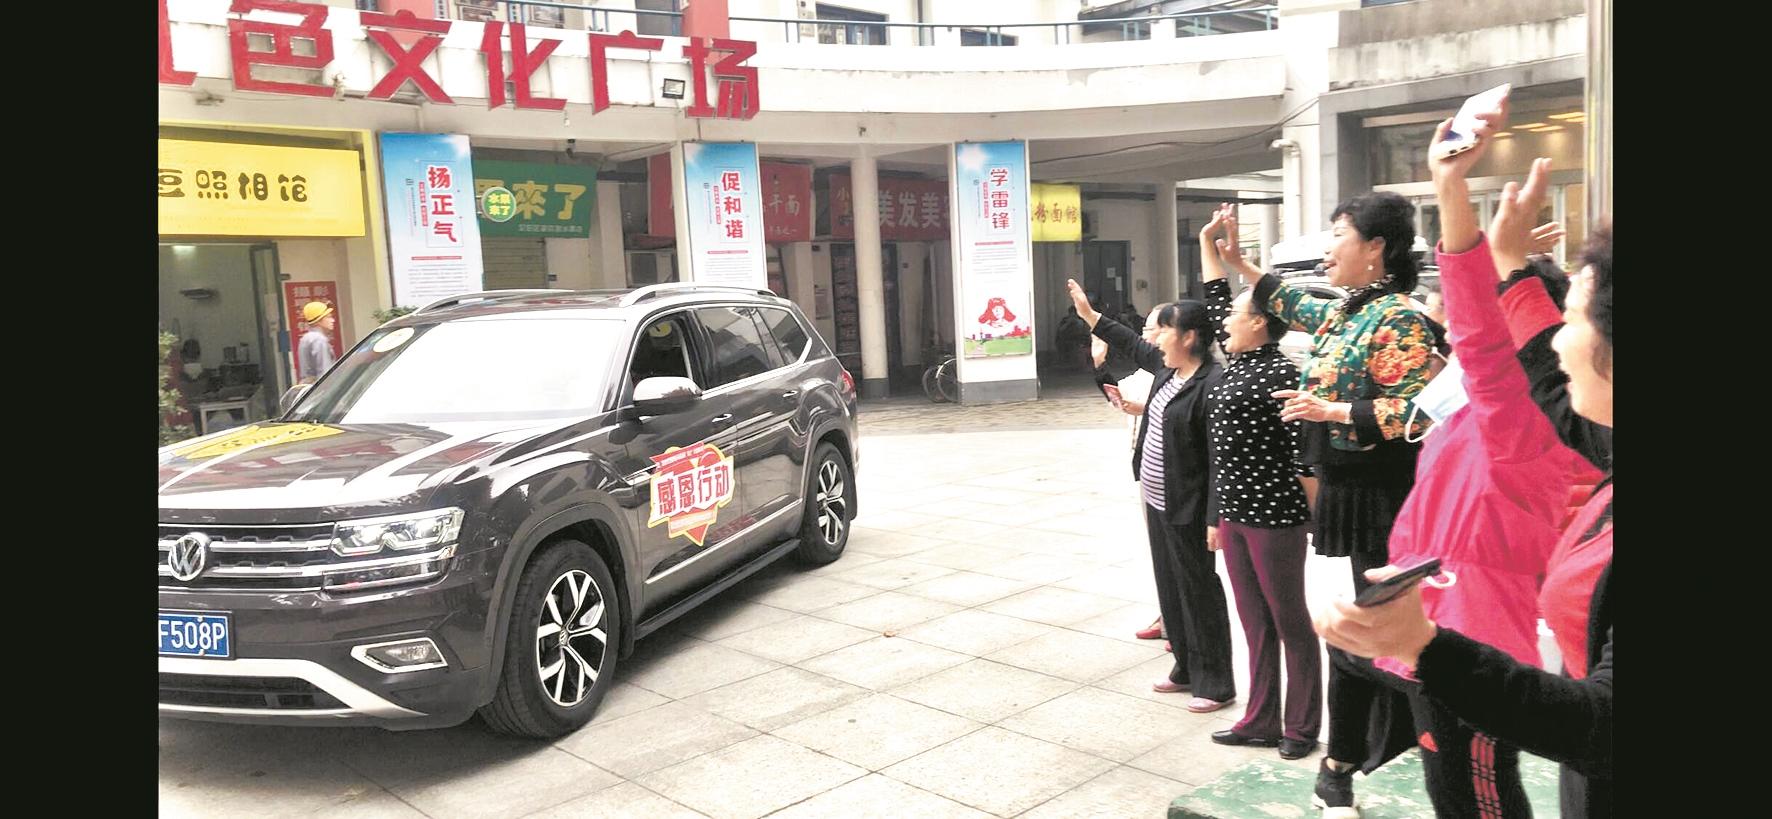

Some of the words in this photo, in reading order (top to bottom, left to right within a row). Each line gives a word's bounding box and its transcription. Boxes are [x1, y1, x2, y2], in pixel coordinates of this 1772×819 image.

[428, 166, 457, 243] 扬正气
[722, 171, 744, 240] 促和谐
[879, 189, 949, 228] 美发美
[990, 168, 1009, 229] 学雷锋
[1031, 202, 1078, 224] 粉面馆
[657, 465, 729, 515] 感恩行动
